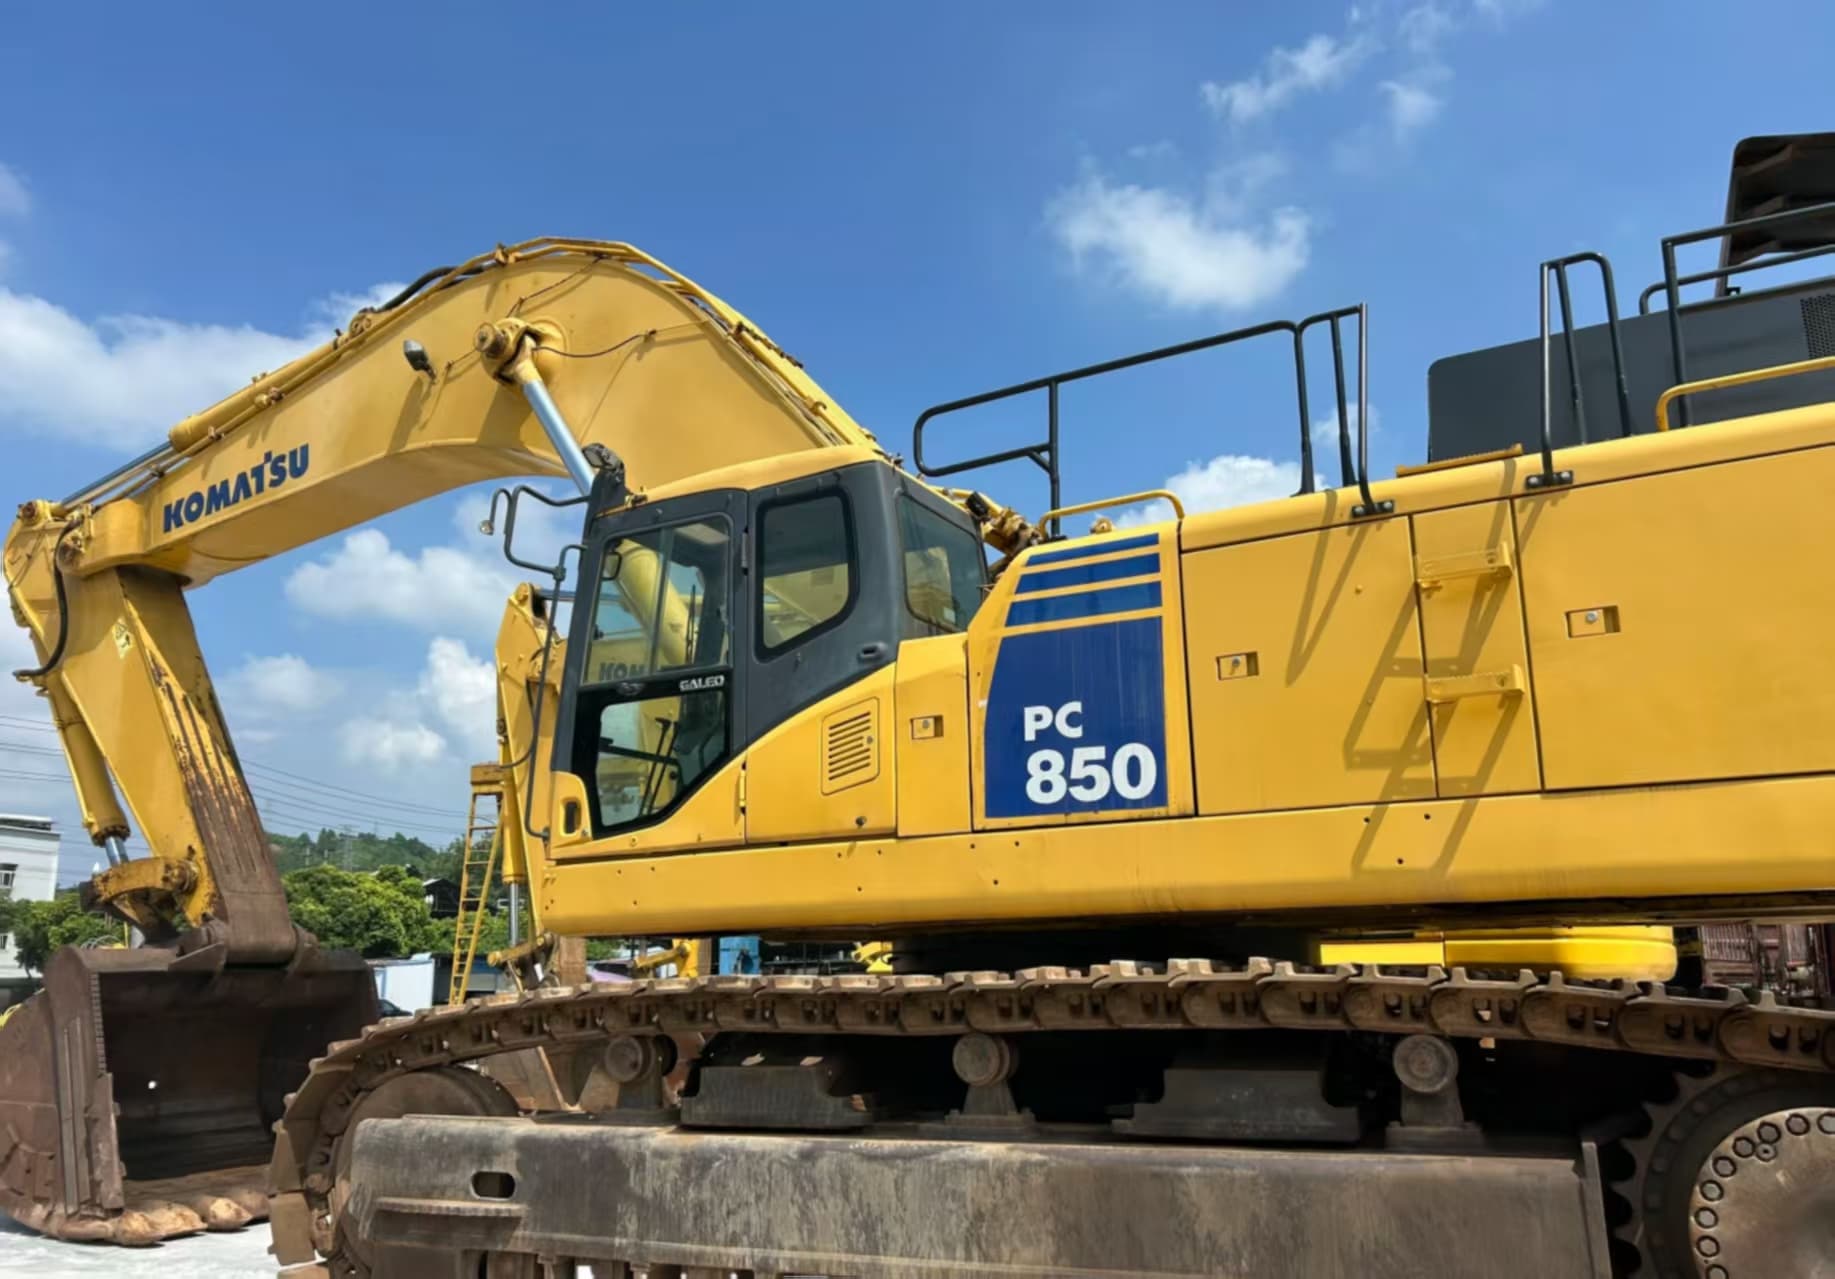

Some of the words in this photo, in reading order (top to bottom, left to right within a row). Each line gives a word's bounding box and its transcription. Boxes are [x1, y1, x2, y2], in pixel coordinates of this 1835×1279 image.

[163, 443, 309, 533] KOMATSU
[679, 674, 725, 692] GALEO
[1024, 701, 1083, 742] PC
[1026, 742, 1157, 805] 850
